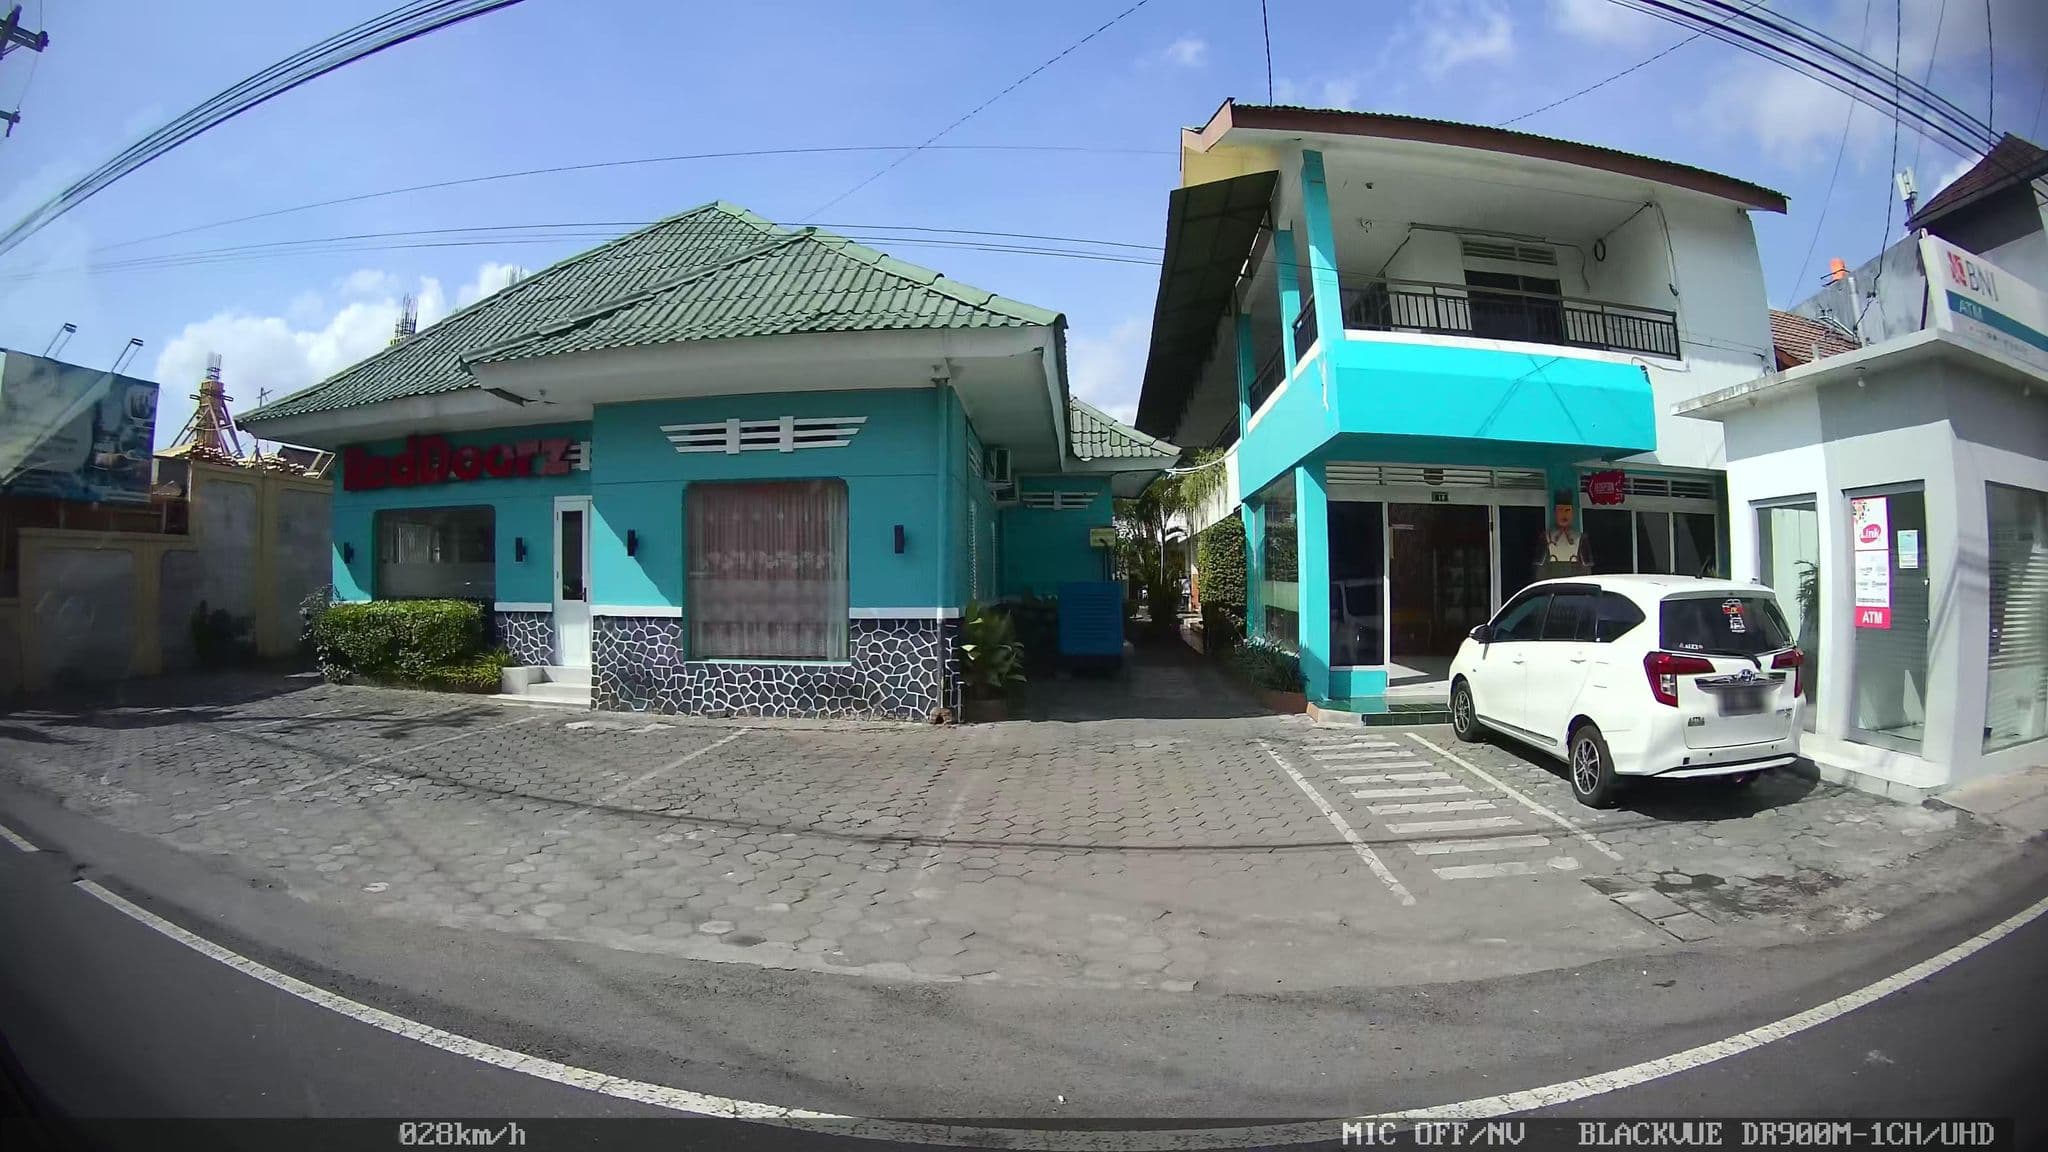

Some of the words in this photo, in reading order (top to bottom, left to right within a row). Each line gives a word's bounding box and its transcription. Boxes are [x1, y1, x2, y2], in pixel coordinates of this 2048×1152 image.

[1966, 260, 1998, 302] BNI
[1960, 300, 1983, 320] ATM
[343, 435, 570, 491] RedDoorz
[1862, 611, 1883, 625] ATM
